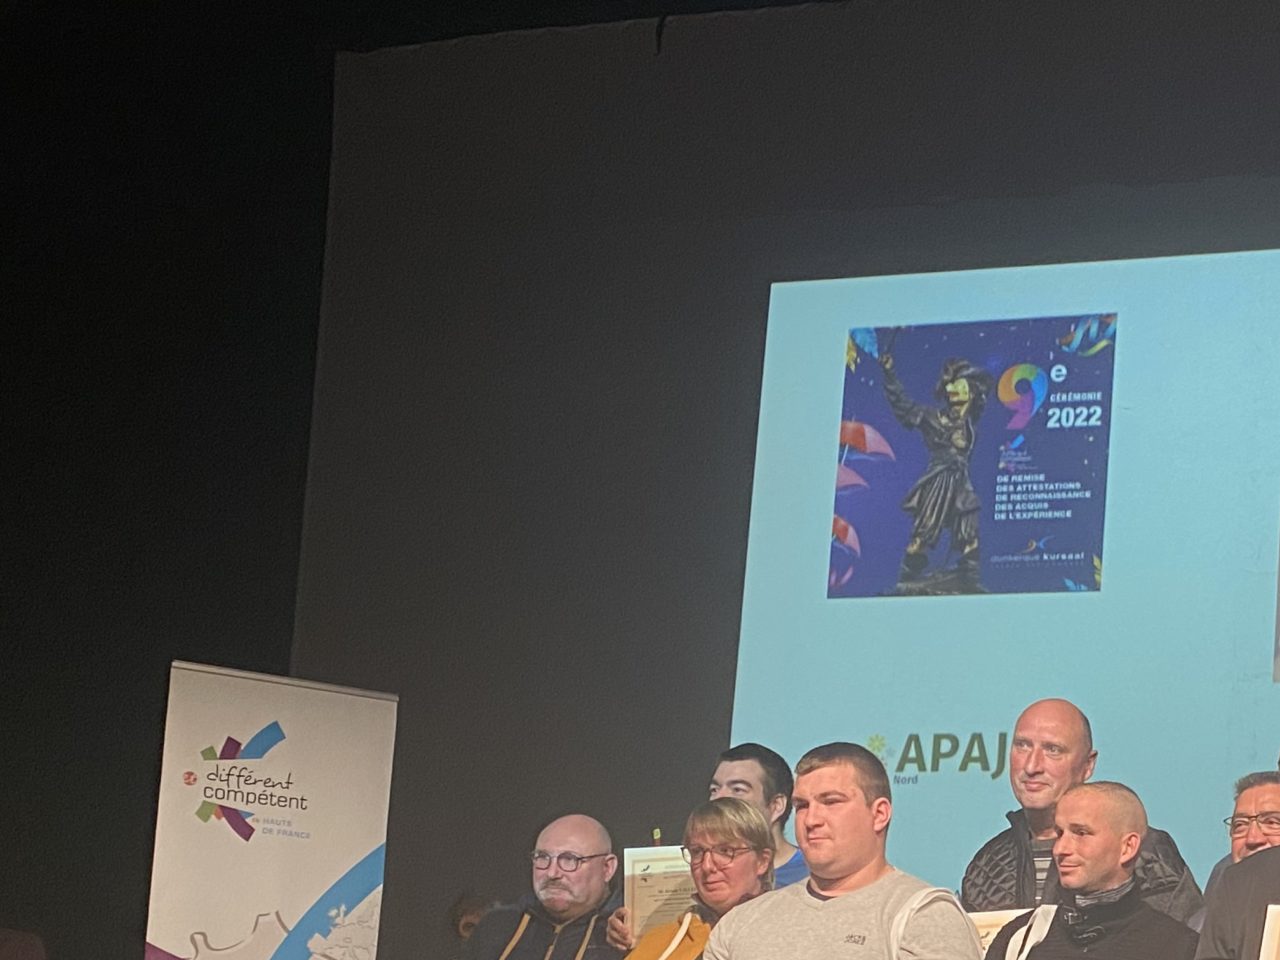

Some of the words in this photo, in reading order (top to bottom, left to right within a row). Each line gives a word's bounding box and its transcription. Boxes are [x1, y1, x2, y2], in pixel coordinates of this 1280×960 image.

[998, 363, 1048, 429] 9
[1050, 364, 1067, 382] e
[1046, 405, 1102, 428] 2022
[996, 475, 1009, 483] DE
[1011, 473, 1045, 482] REMISE
[895, 732, 1007, 780] APAJ
[206, 764, 294, 789] différent
[893, 775, 918, 785] Nord
[203, 786, 308, 810] compétent
